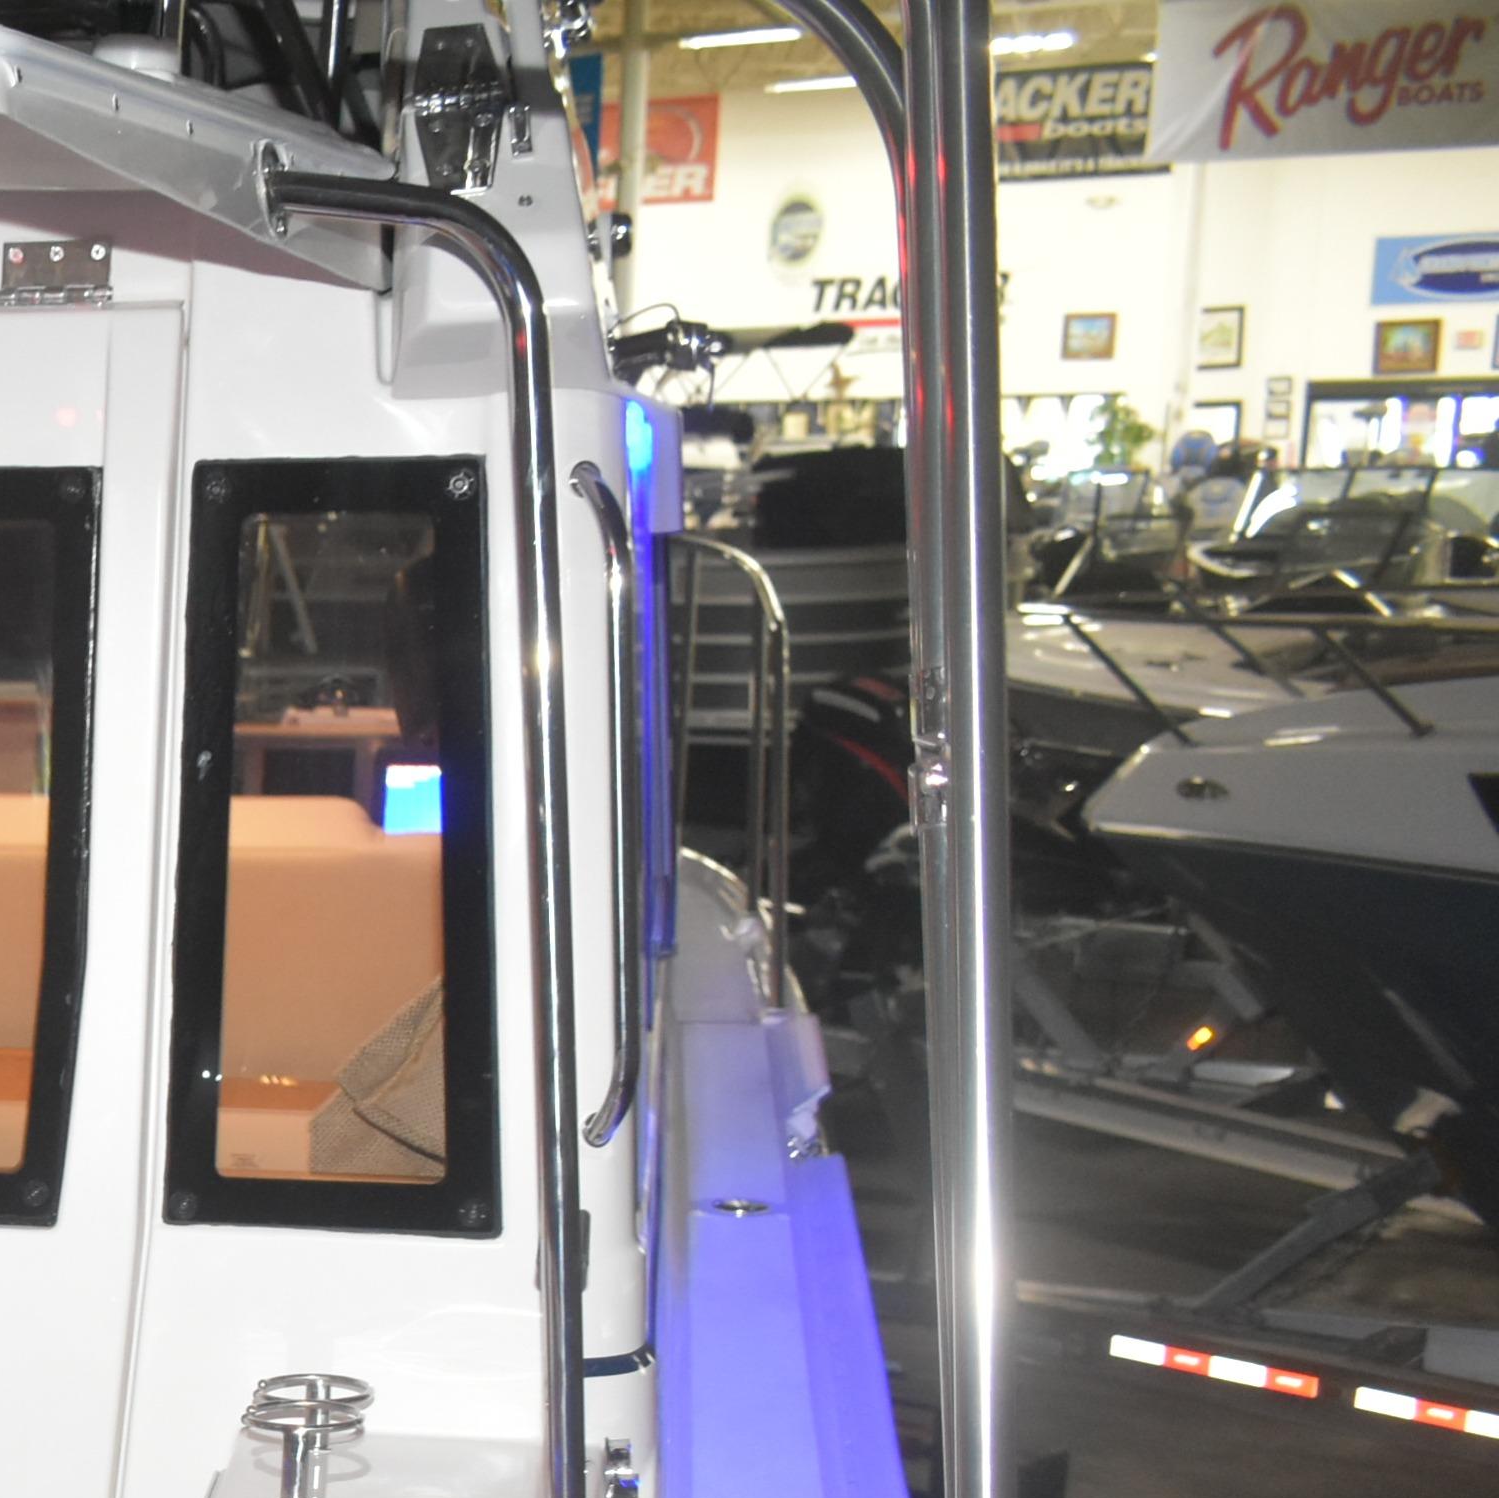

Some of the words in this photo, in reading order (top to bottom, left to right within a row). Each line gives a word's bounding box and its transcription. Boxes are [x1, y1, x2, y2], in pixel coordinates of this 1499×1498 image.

[996, 68, 1151, 122] ACKER
[1212, 6, 1485, 151] Ranger
[1397, 82, 1484, 107] BOATS
